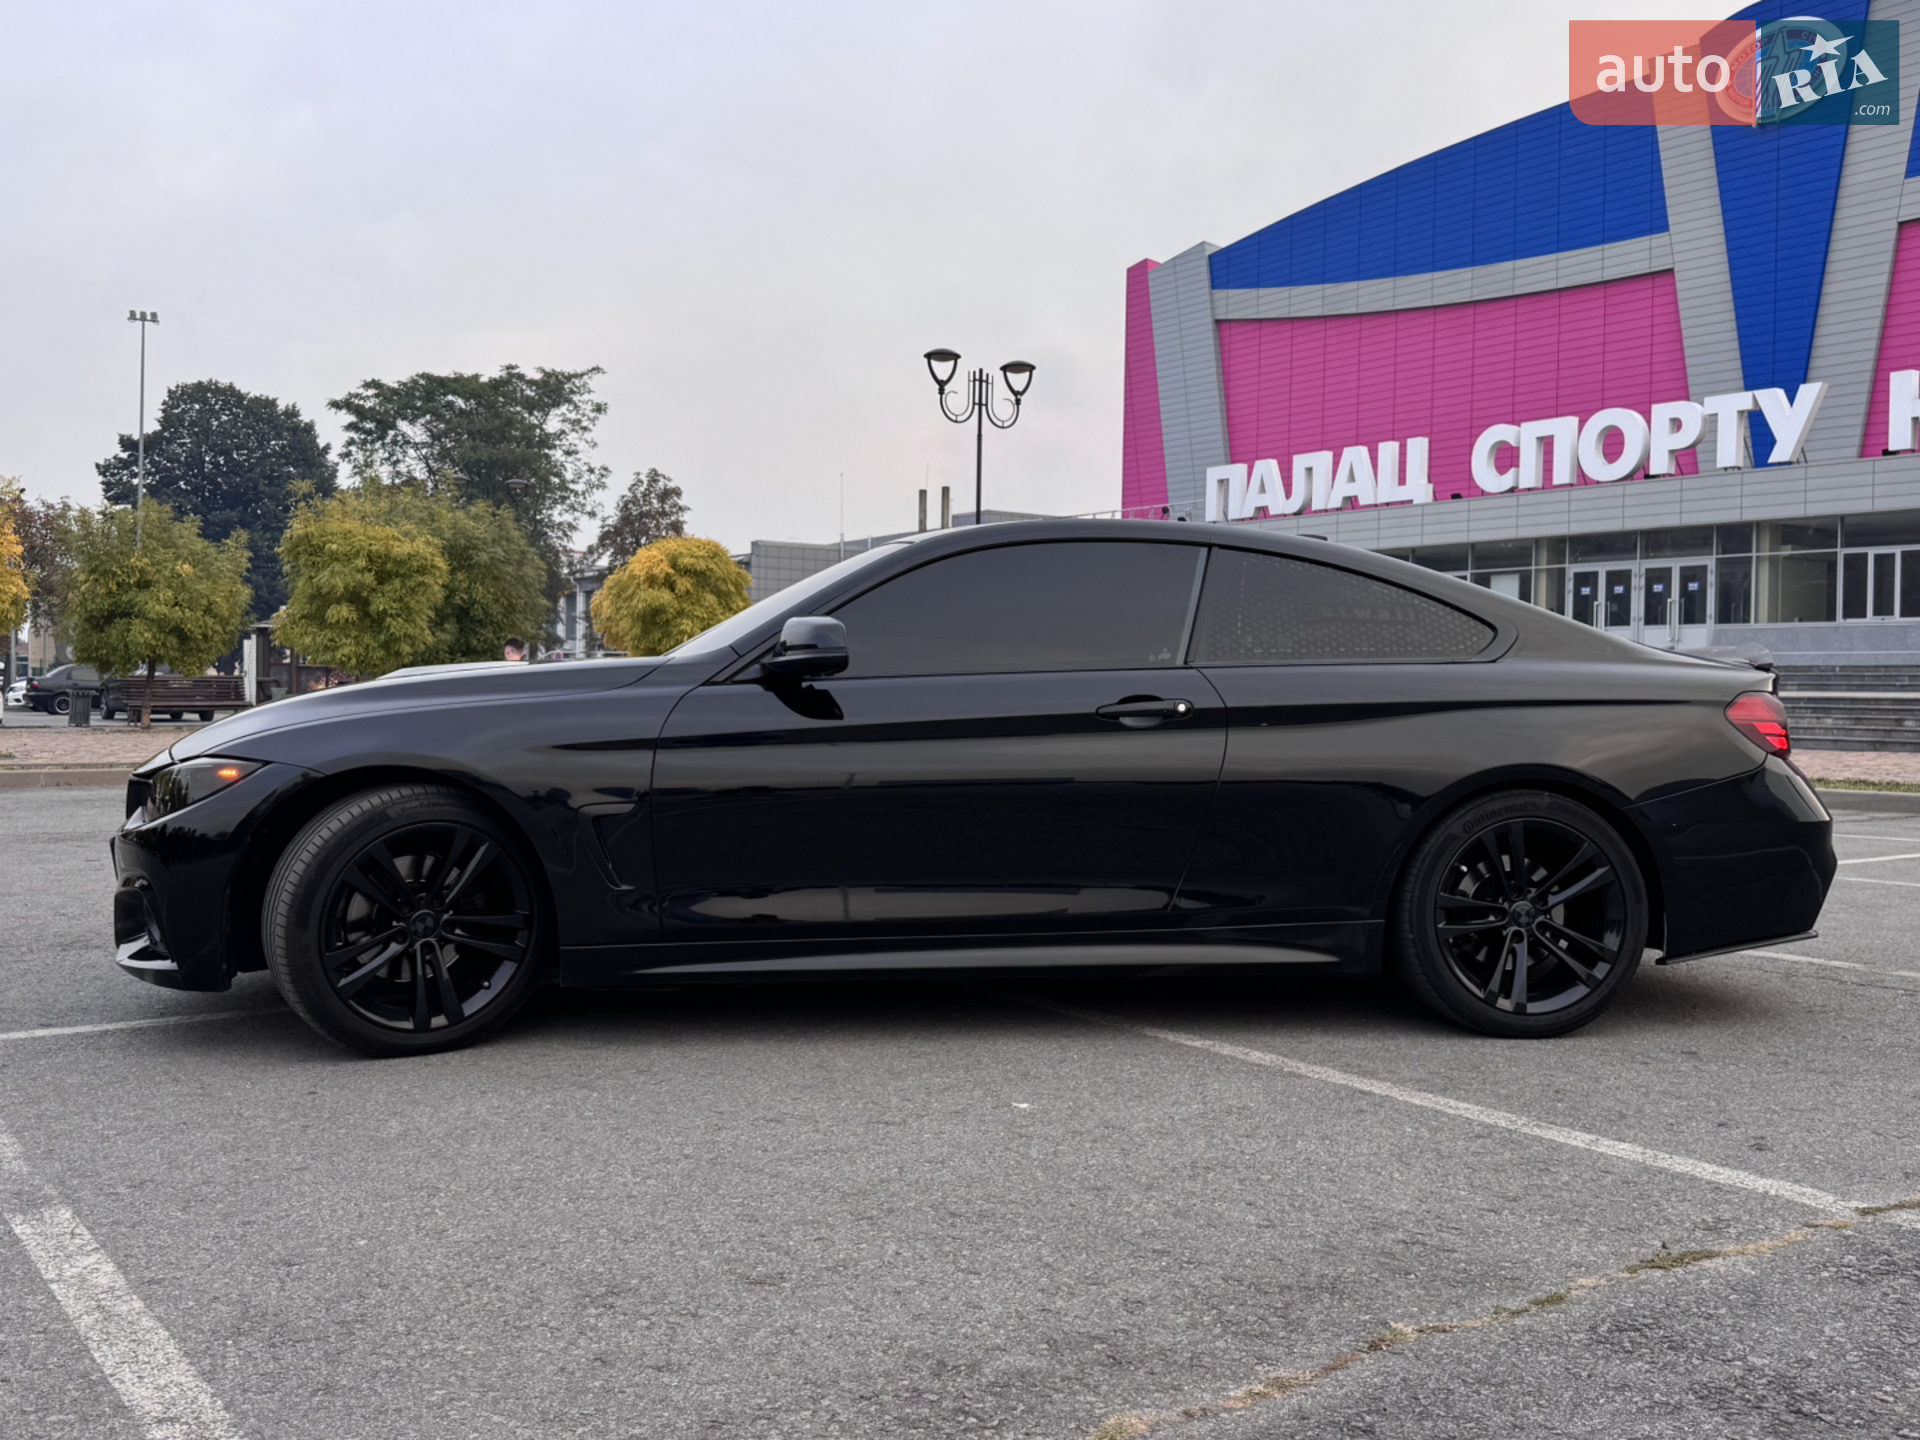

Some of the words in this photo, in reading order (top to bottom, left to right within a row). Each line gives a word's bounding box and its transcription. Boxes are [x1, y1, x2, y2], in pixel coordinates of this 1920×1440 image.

[1205, 436, 1434, 523] ПАЛАЦ
[1471, 381, 1829, 494] СПОРТУ
[1461, 801, 1529, 835] Continental
